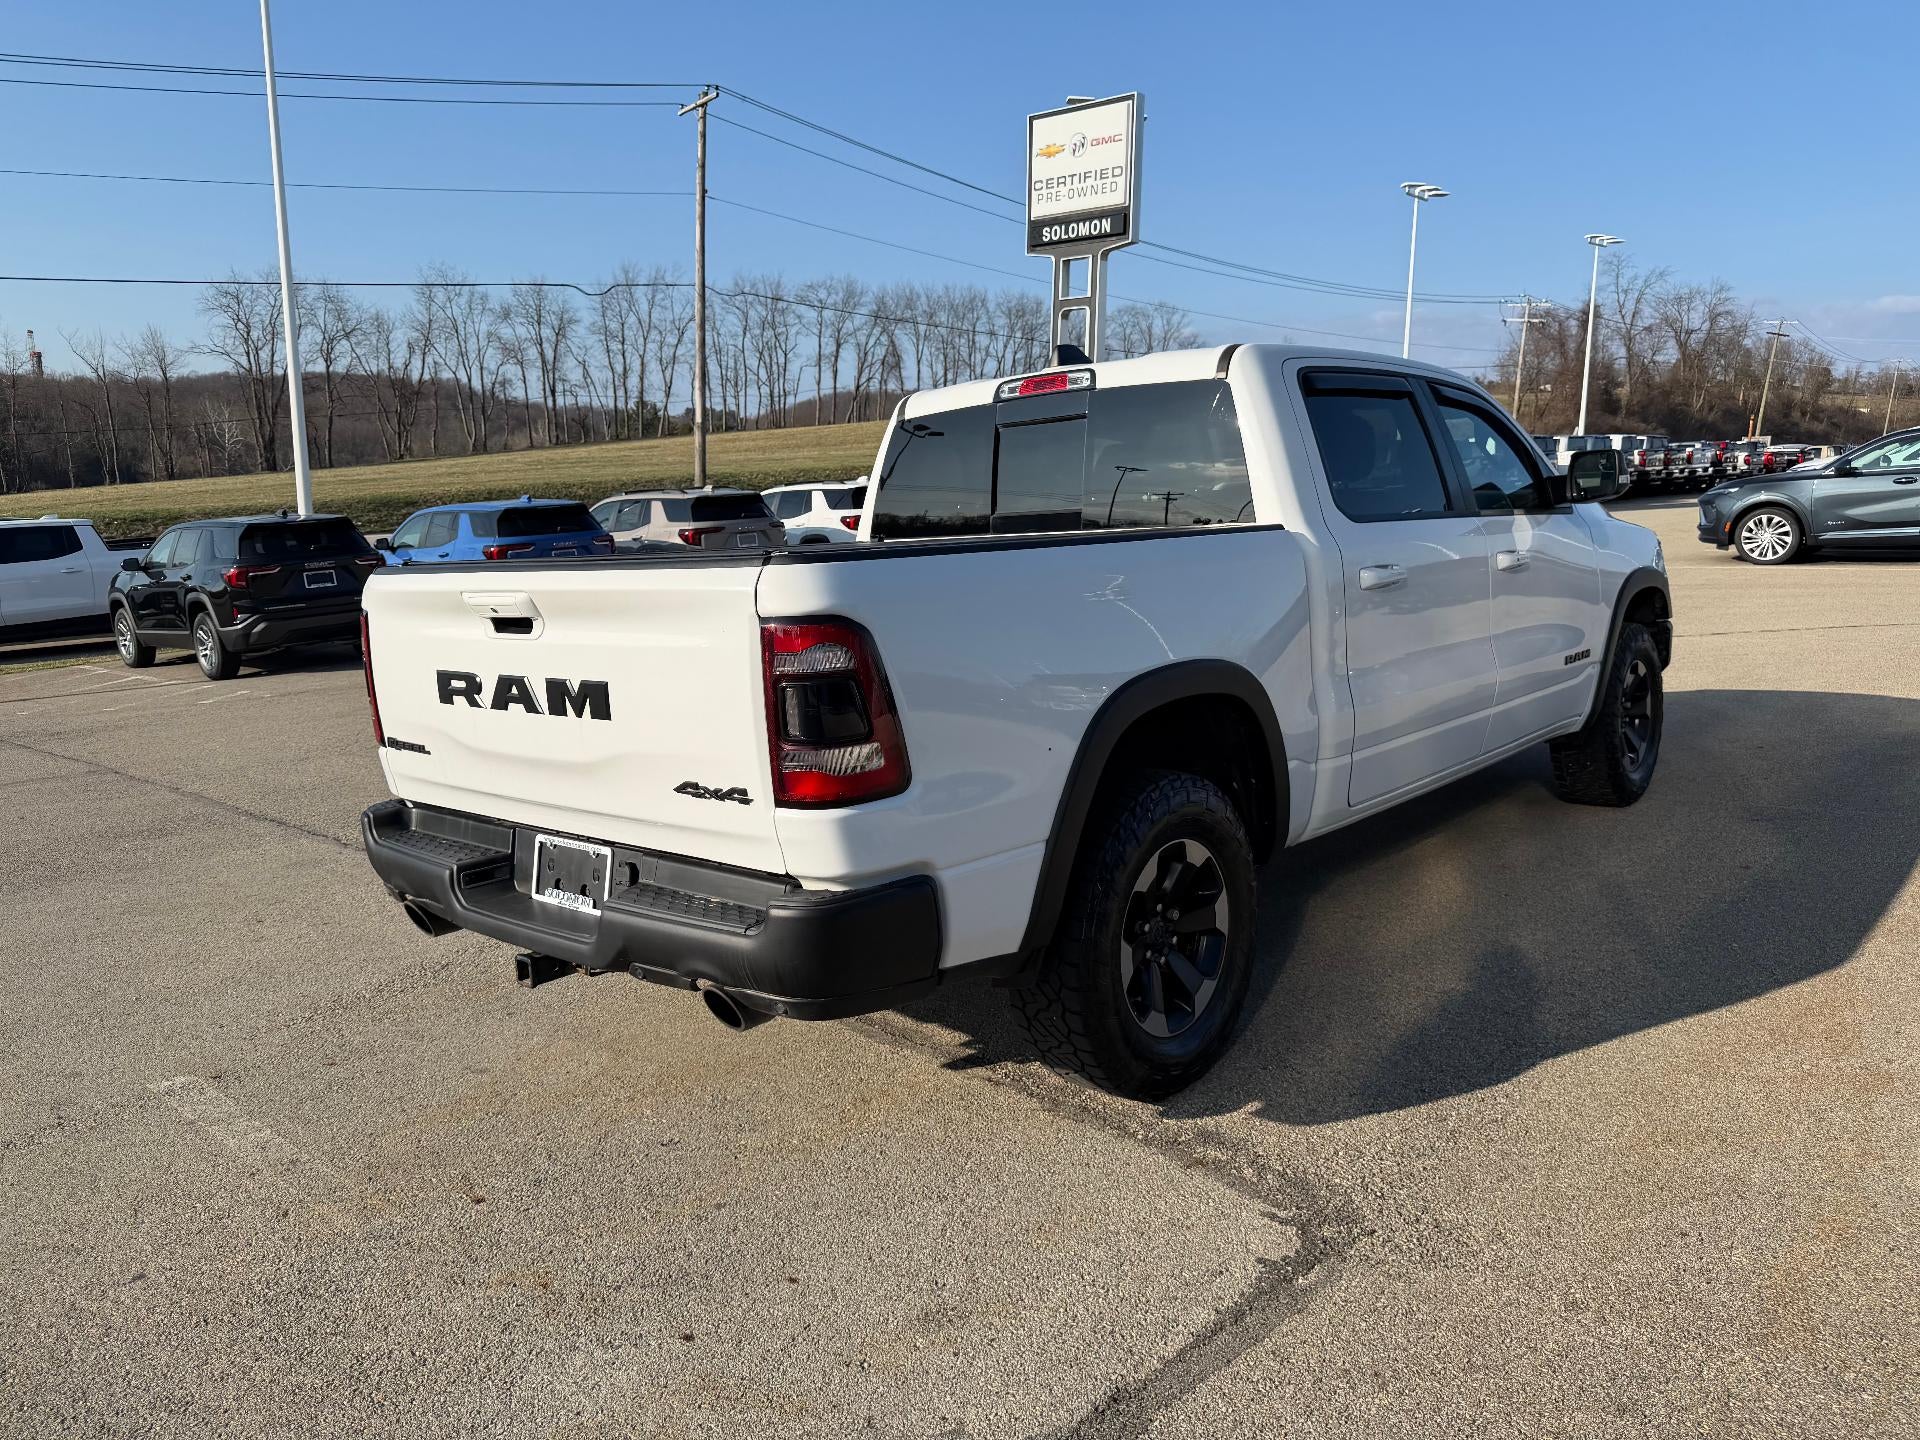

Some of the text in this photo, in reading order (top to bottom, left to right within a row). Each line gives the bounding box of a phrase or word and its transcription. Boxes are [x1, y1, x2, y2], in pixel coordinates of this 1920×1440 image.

[1090, 134, 1123, 147] GMC
[1033, 165, 1124, 192] CERTIFIED
[1037, 181, 1118, 204] PRE-OWNED
[1042, 217, 1111, 242] SOLOMON
[1564, 648, 1591, 666] RAM
[436, 669, 612, 721] RAM
[544, 887, 593, 909] SOLOMON
